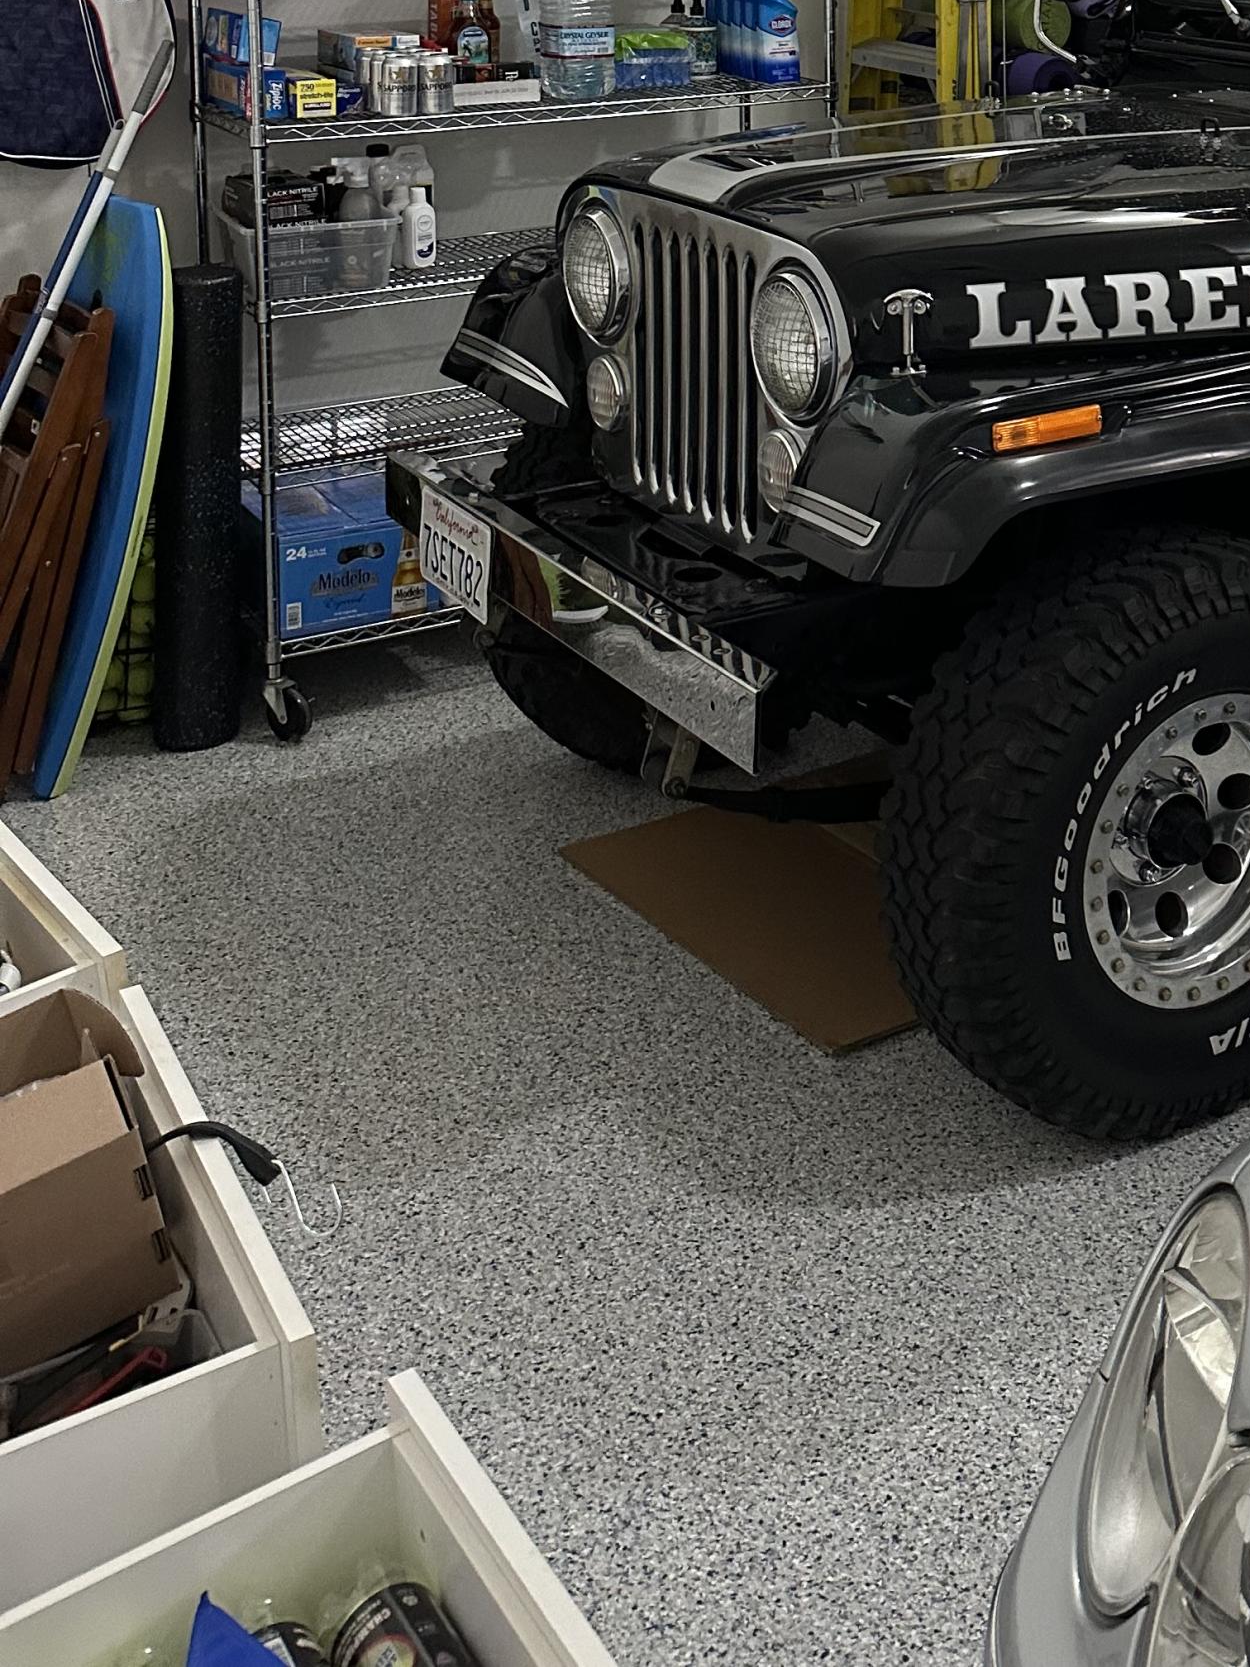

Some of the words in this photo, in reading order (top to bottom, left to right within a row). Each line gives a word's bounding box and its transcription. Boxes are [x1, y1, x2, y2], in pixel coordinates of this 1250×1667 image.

[268, 83, 283, 111] Ziploc
[267, 189, 288, 198] LACK
[289, 186, 318, 195] NITRILE
[286, 546, 307, 562] 24
[424, 522, 483, 607] 7SET782
[318, 568, 371, 591] Modelo
[1051, 666, 1198, 962] BFGoodrich
